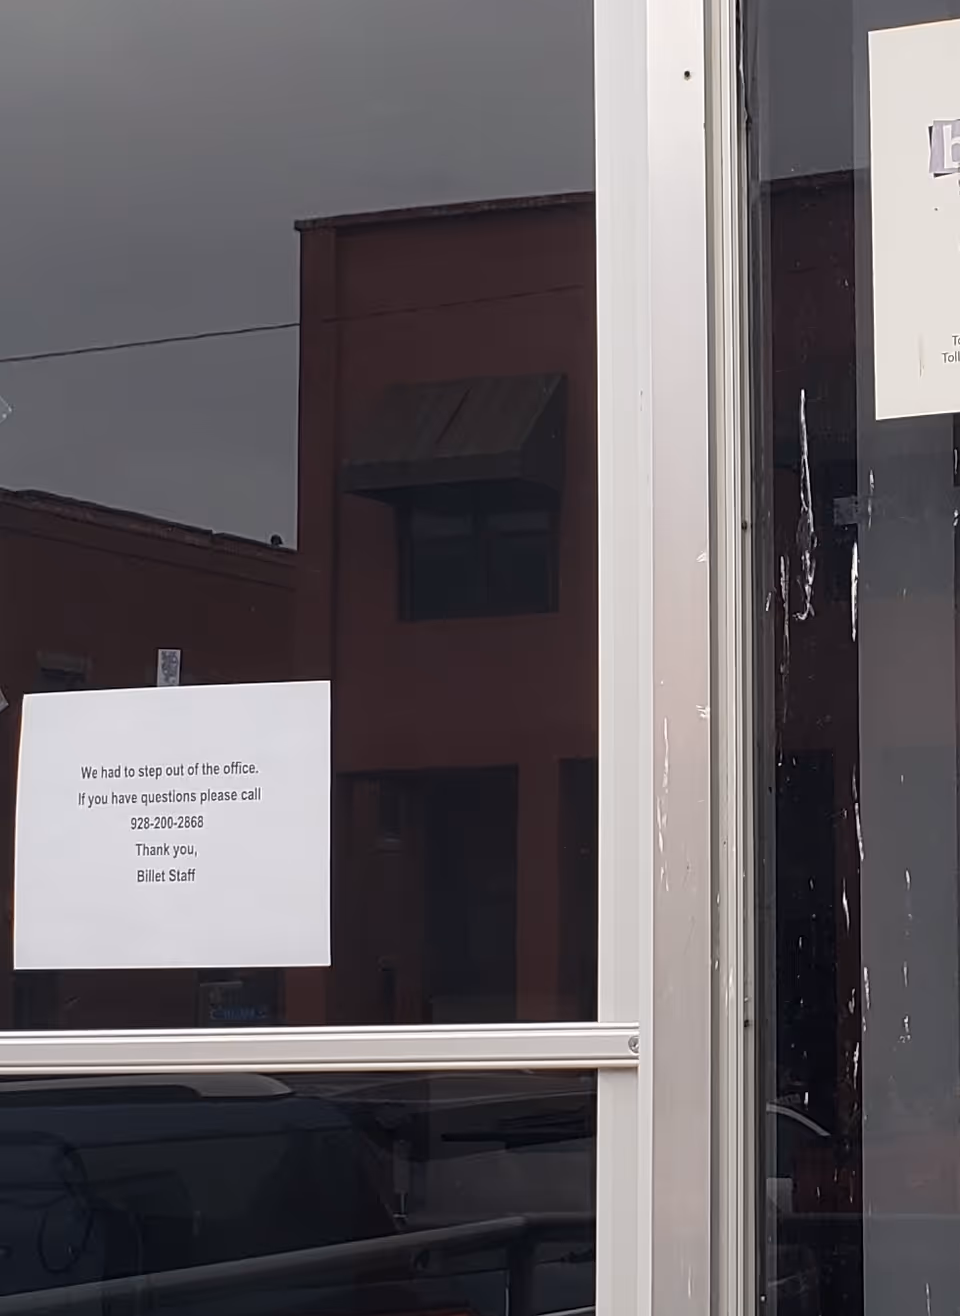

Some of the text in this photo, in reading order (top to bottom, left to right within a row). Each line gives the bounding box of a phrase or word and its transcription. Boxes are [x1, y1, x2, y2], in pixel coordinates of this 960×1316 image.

[941, 351, 960, 364] Toll
[81, 762, 259, 780] We had to step out of the office.
[78, 787, 261, 808] If you have questions please call
[130, 815, 204, 830] 928-200-2868
[135, 843, 198, 858] Thank you,
[137, 868, 196, 882] Billet Staff
